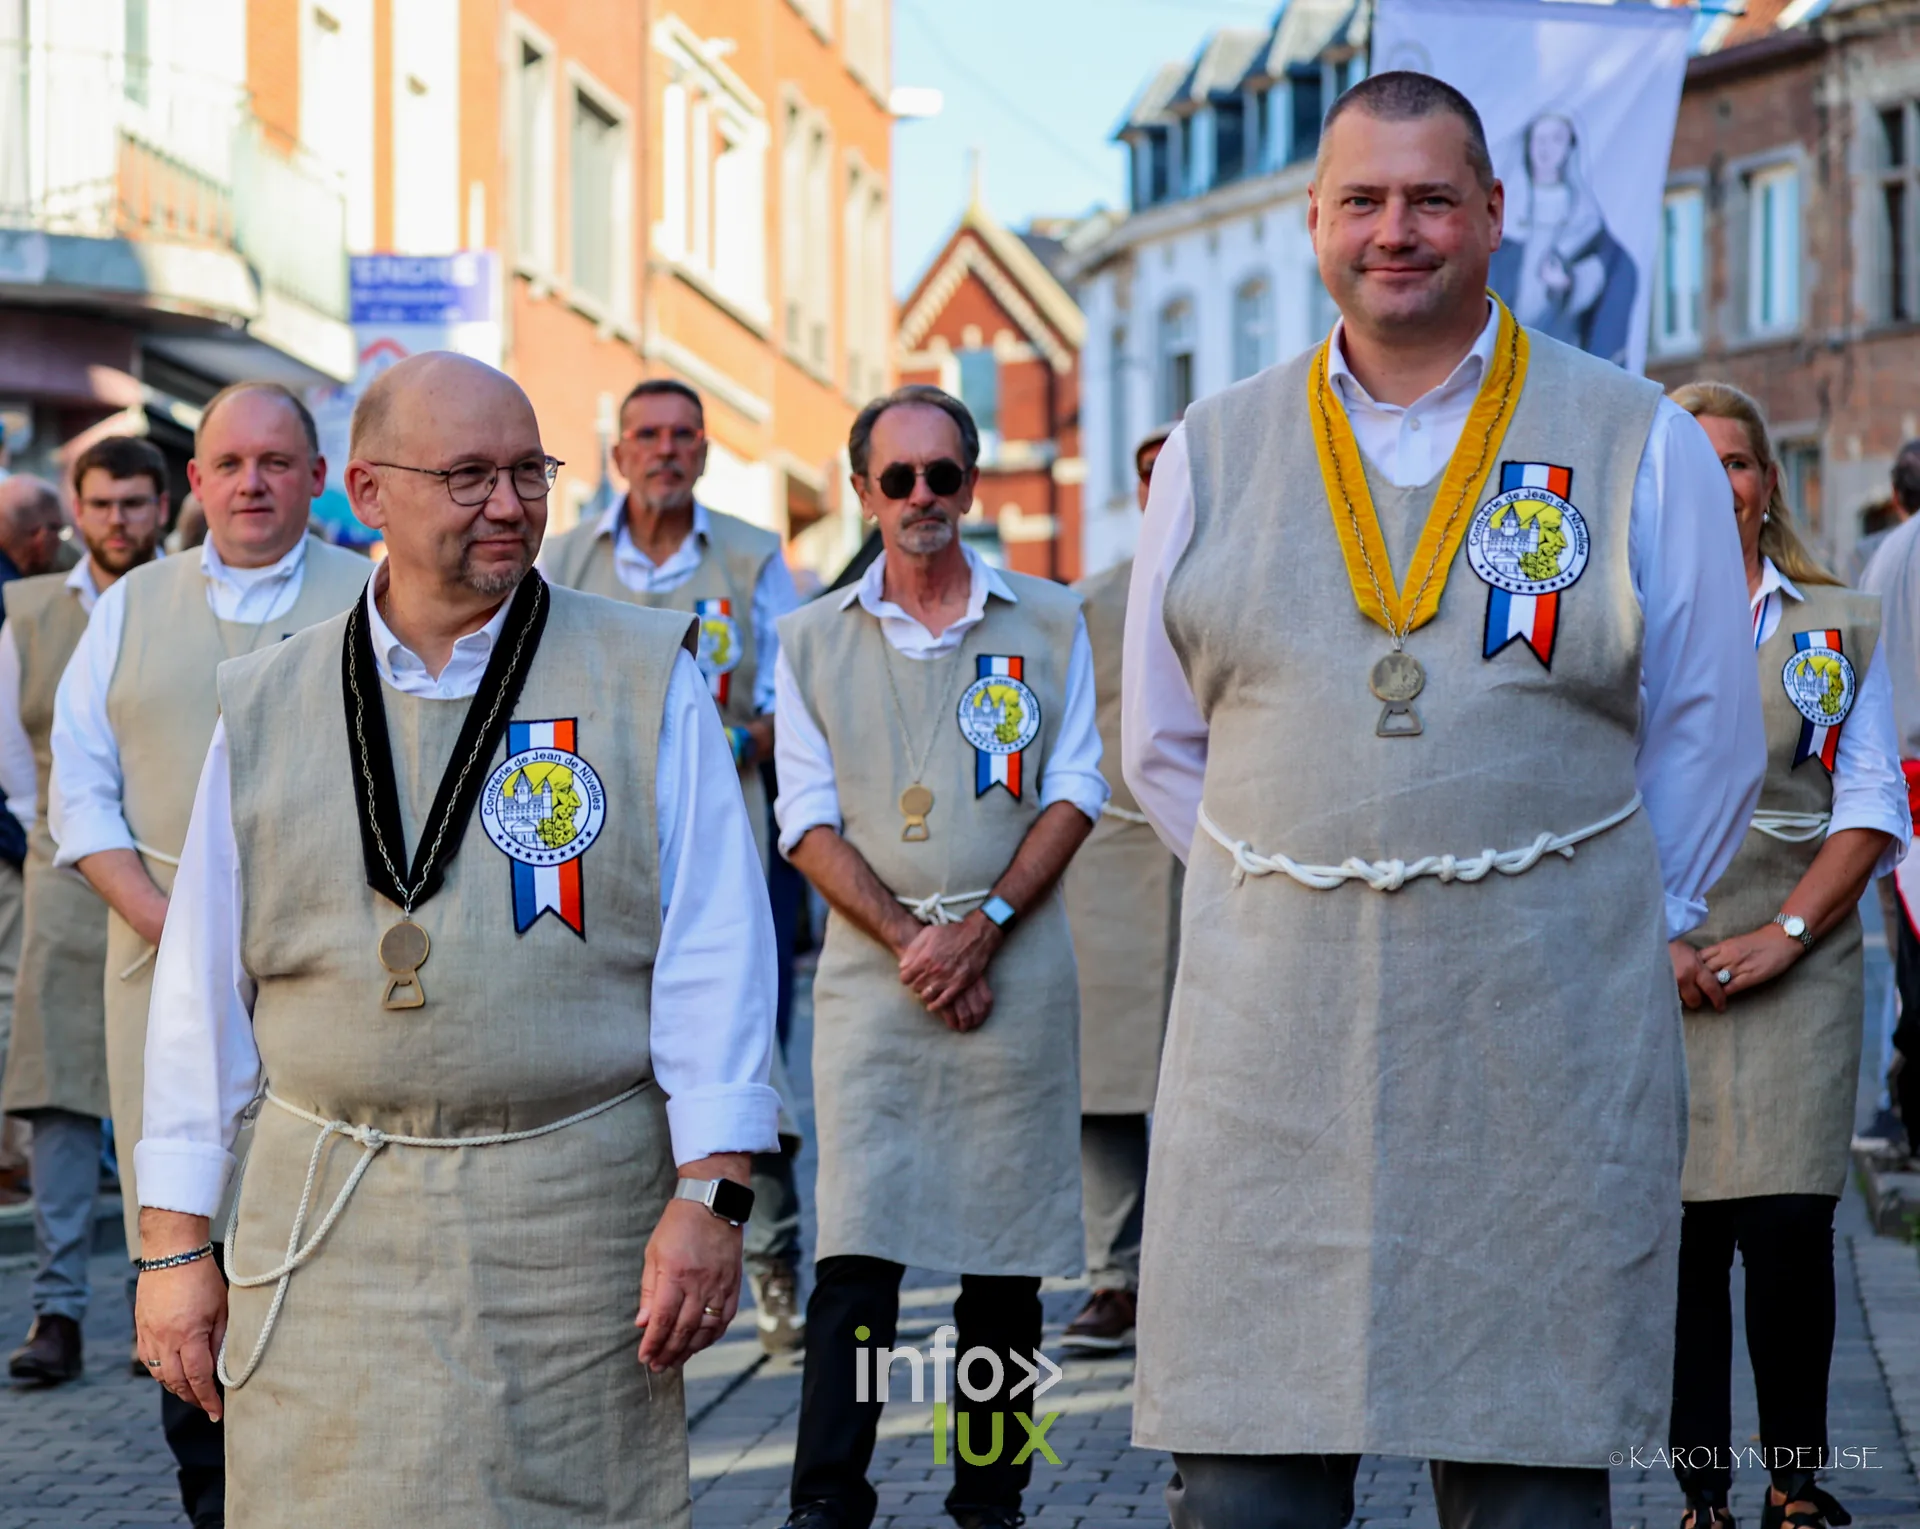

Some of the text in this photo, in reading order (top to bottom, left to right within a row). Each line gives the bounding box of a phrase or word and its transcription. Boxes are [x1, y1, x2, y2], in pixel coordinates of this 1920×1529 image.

[1505, 492, 1520, 502] de
[1524, 489, 1554, 503] Jean
[1556, 500, 1569, 513] de
[1569, 512, 1586, 556] Nivelles
[483, 751, 601, 816] Confrérie de Jean de Nivelles
